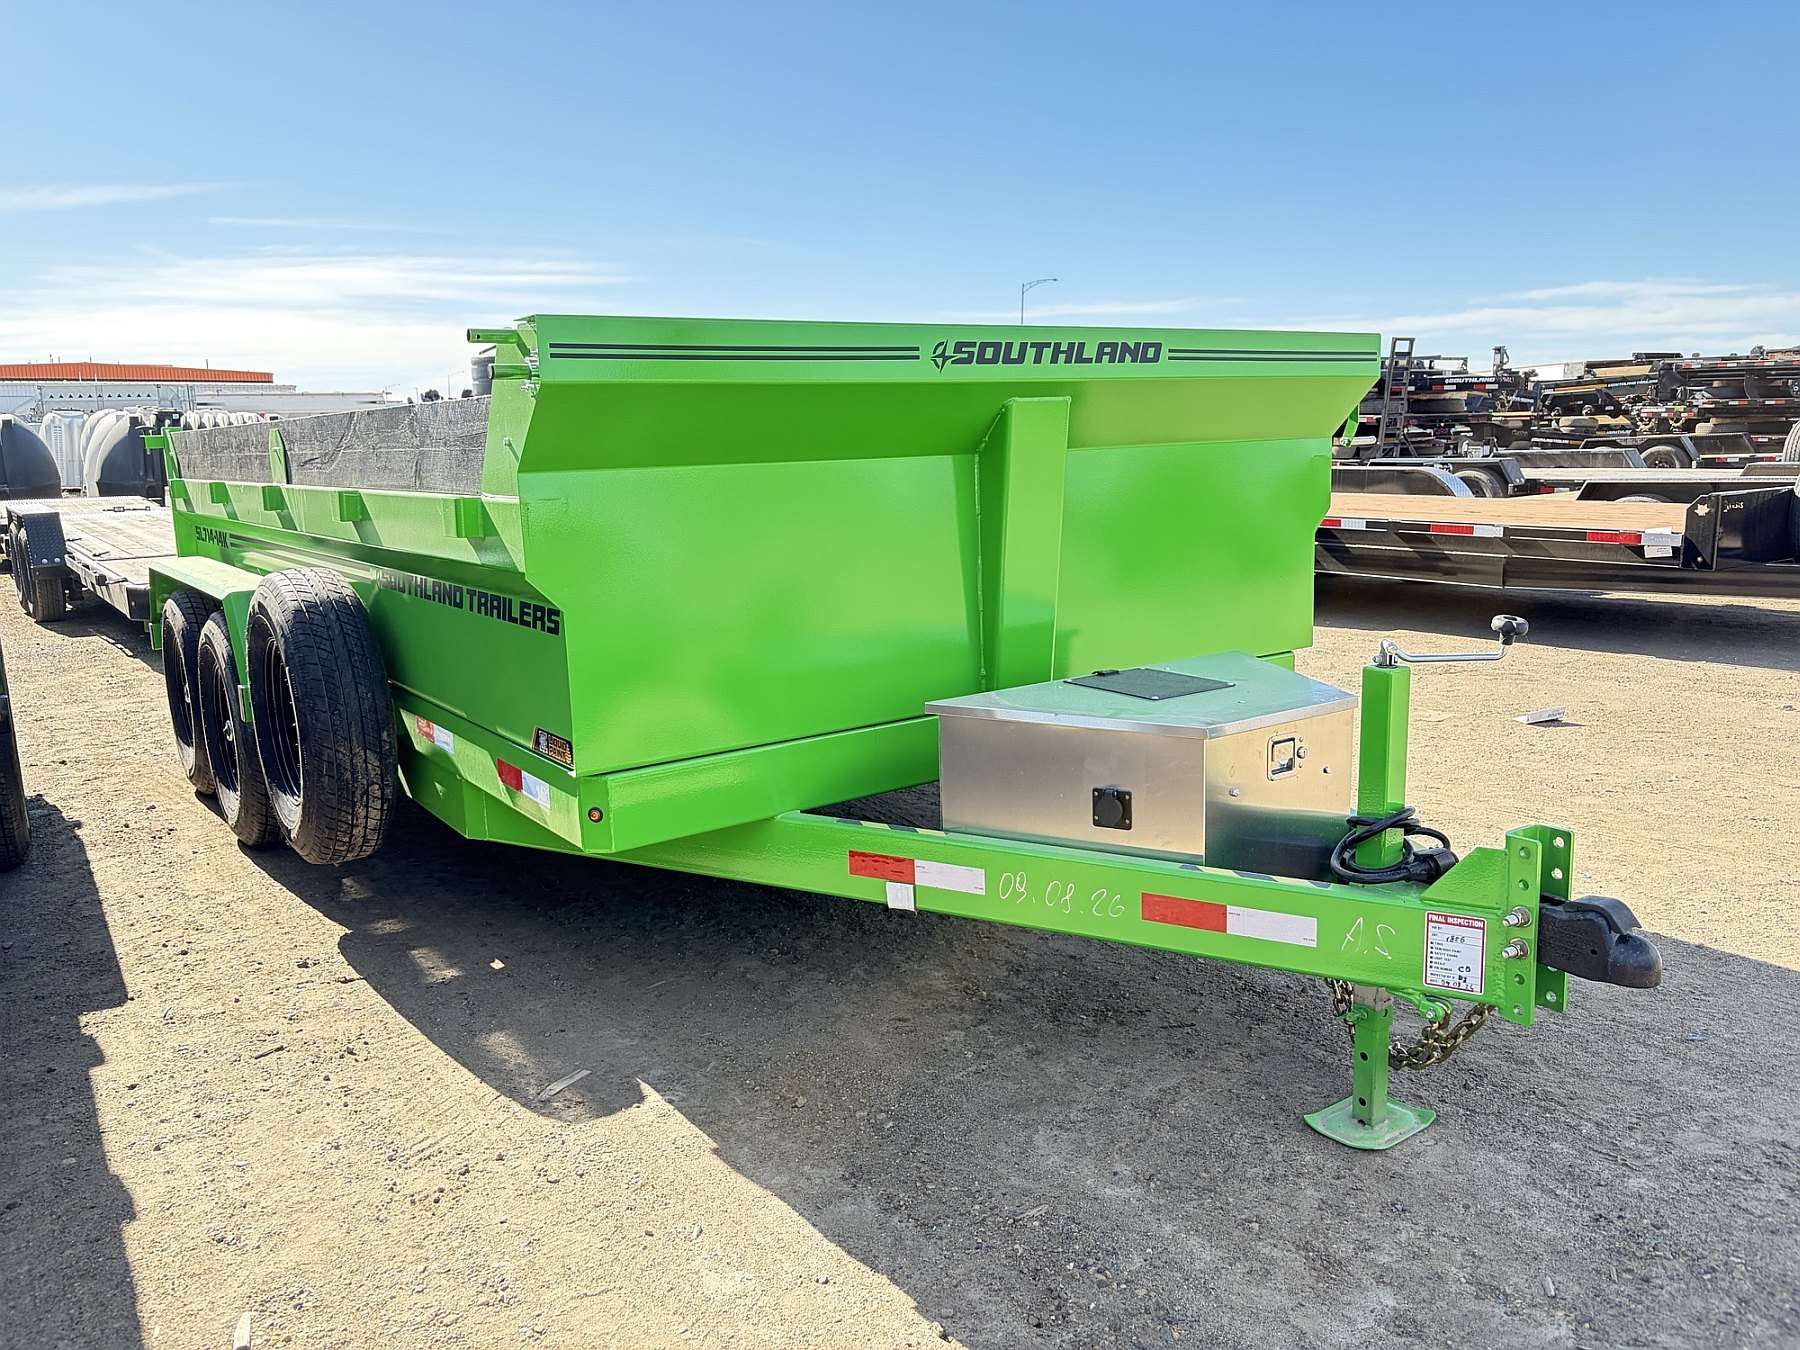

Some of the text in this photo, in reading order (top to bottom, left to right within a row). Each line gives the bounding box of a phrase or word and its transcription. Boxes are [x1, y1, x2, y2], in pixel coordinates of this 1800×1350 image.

[950, 341, 1163, 365] SOUTHLAND
[381, 574, 561, 636] SOUTHLAND TRAILERS
[1428, 914, 1446, 923] FINAL
[1447, 916, 1484, 928] INSPECTION
